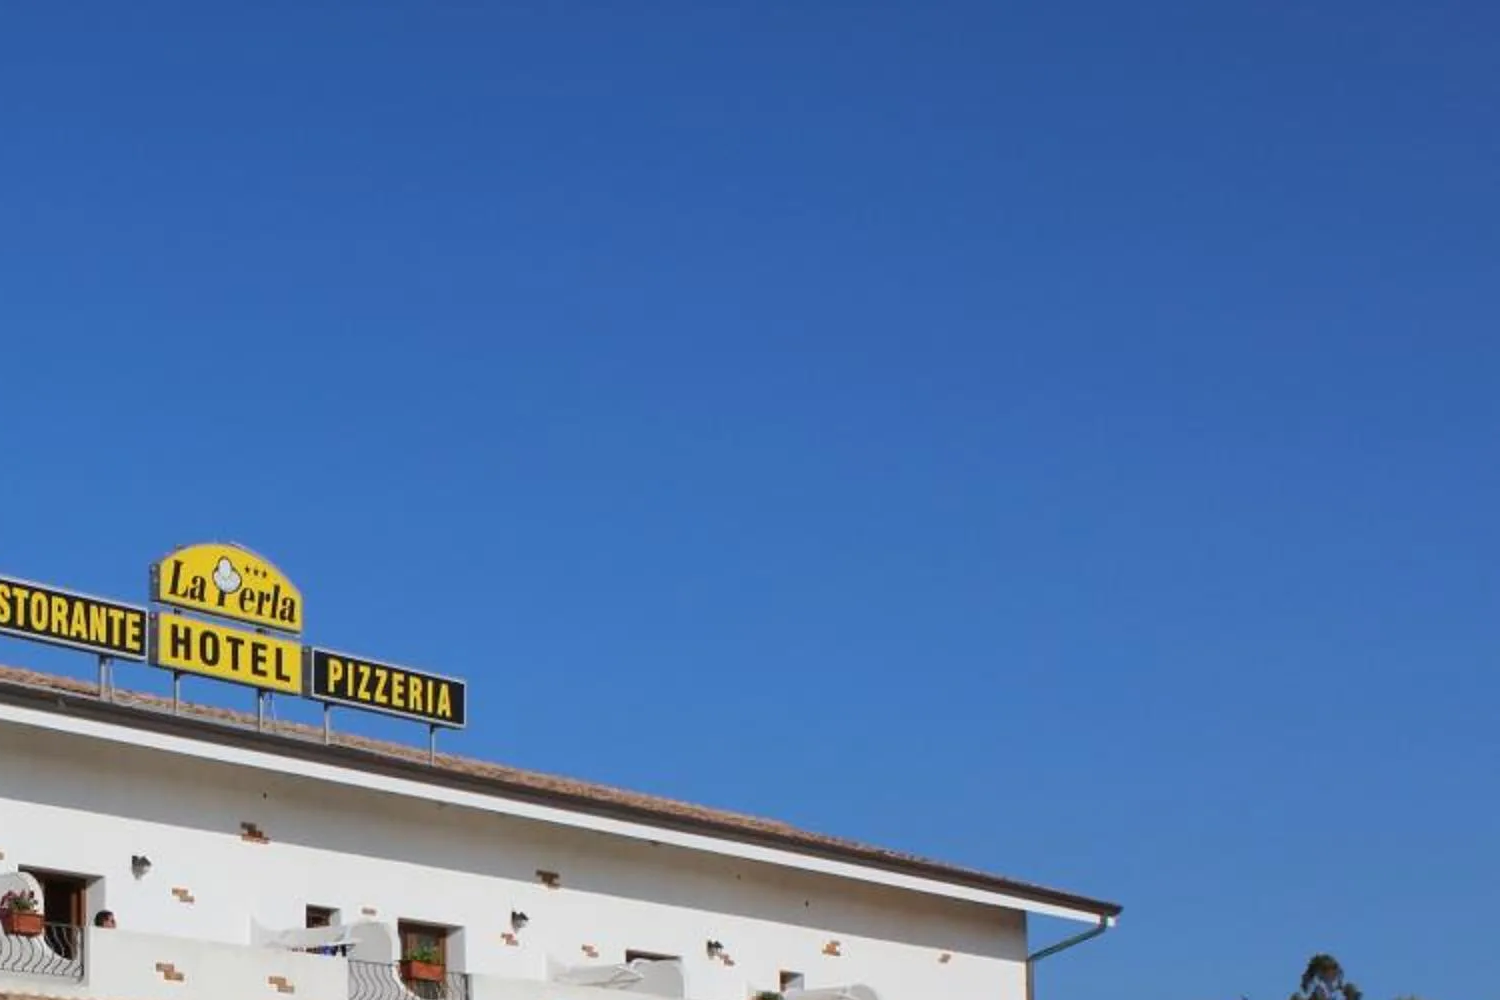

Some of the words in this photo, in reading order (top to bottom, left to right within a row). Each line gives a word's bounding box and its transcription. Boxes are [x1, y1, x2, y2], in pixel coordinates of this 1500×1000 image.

[168, 559, 206, 602] La
[170, 623, 292, 683] HOTEL
[327, 657, 453, 719] PIZZERIA
